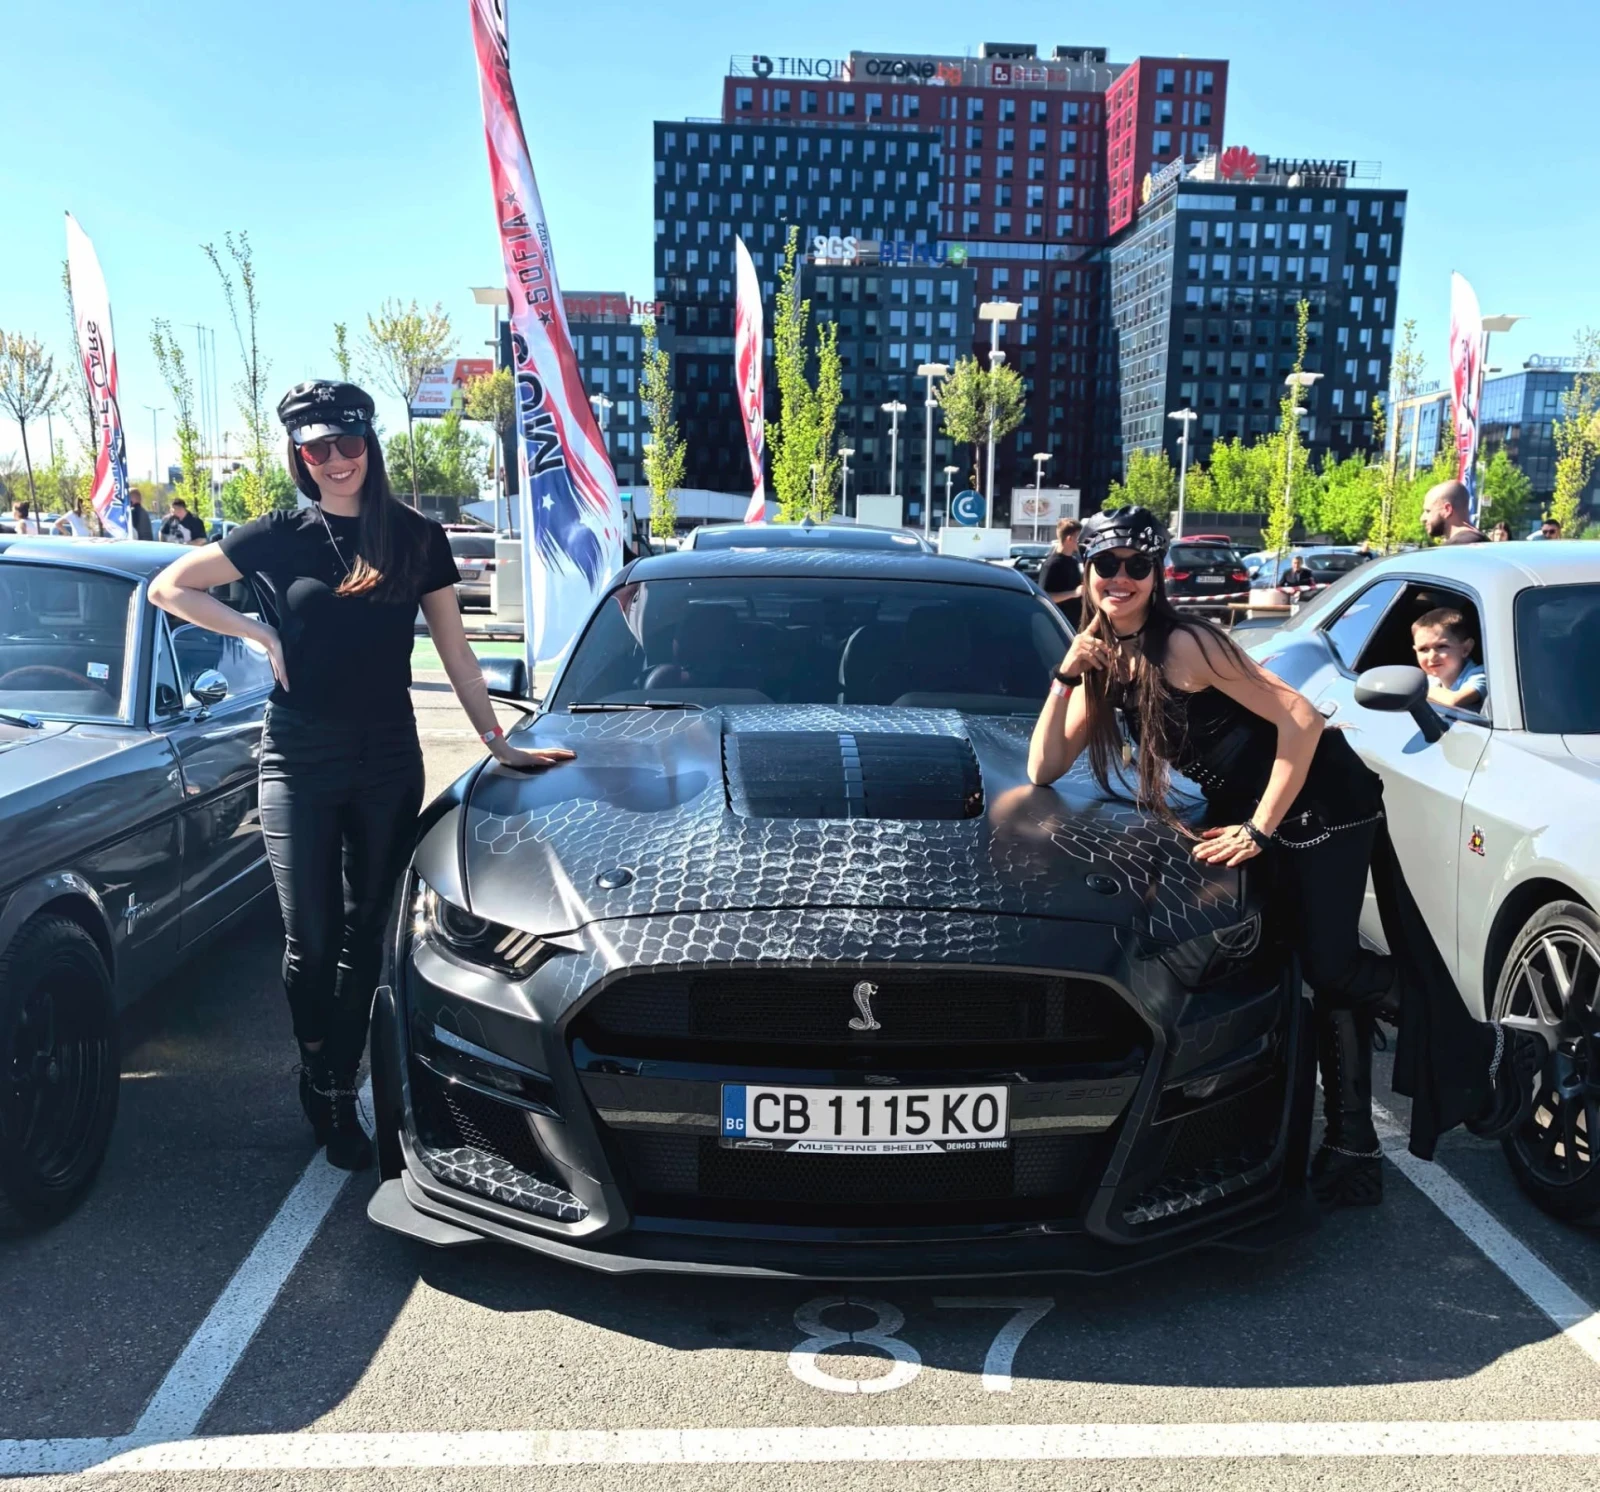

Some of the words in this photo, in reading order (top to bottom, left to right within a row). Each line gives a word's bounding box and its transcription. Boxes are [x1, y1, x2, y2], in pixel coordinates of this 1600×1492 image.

[778, 56, 856, 80] TINQIN
[1265, 157, 1357, 178] HUAWEI
[503, 212, 550, 305] SOFIA
[814, 235, 857, 259] SGS
[725, 1118, 744, 1131] BG
[753, 1093, 811, 1134] CB
[828, 1095, 931, 1136] 1115
[798, 1143, 877, 1152] MUSTANG
[882, 1143, 933, 1152] SHELBY
[946, 1142, 977, 1150] DEIMOS
[978, 1140, 1008, 1149] TUNING
[787, 1295, 1056, 1394] 87
